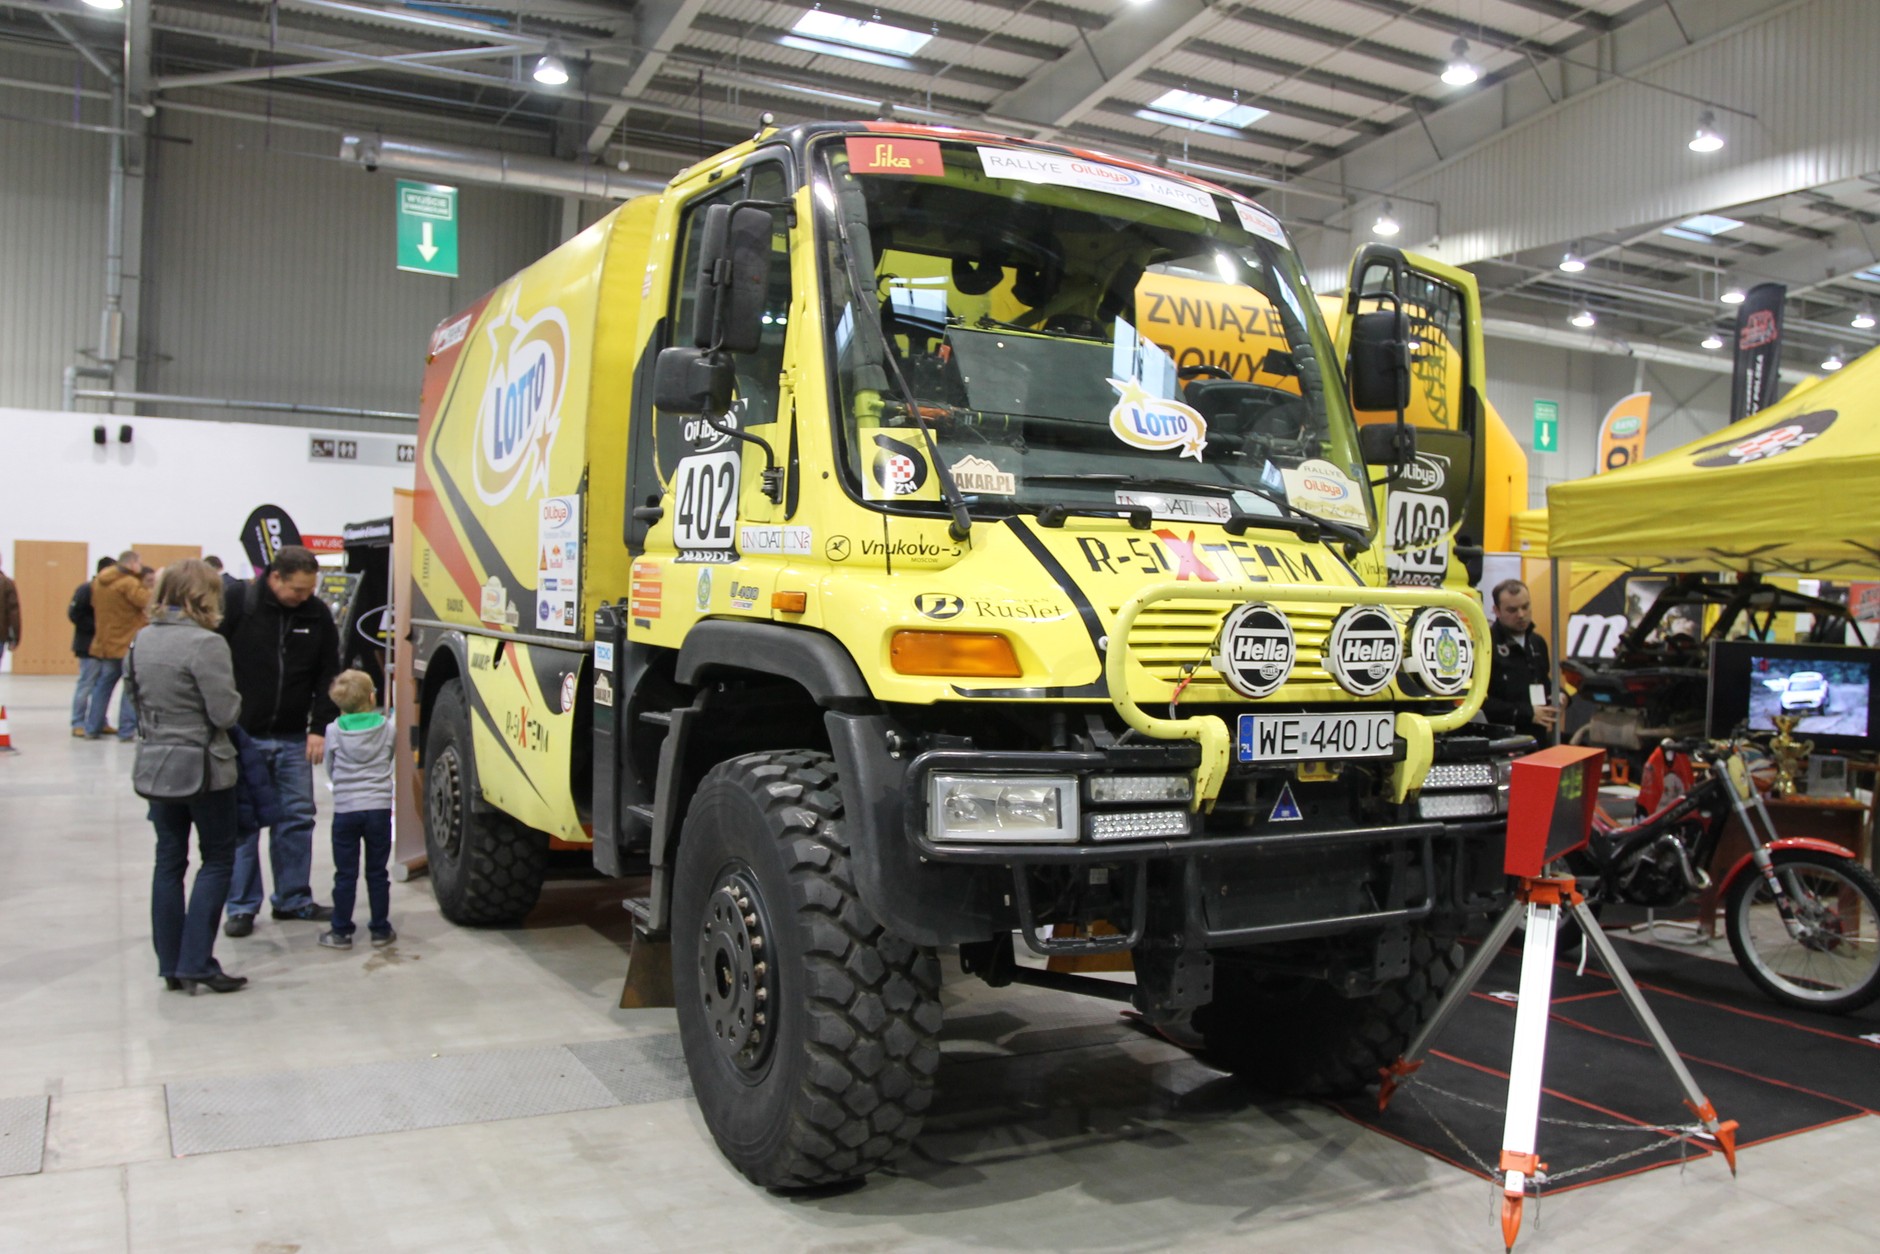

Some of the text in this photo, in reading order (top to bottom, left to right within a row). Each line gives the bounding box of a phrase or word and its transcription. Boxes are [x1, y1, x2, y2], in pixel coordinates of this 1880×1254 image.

[869, 144, 912, 168] Sika
[989, 155, 1063, 174] RALLYE
[1071, 162, 1129, 184] OiLibya
[1150, 183, 1210, 208] MAROC
[493, 352, 546, 460] LOTTO
[1131, 408, 1188, 437] LOTTO
[955, 472, 1014, 493] AKAR.PL
[1303, 465, 1343, 479] RALLYE
[1303, 478, 1343, 497] OiLibya
[678, 461, 736, 541] 402
[1389, 573, 1441, 586] MAROC
[1234, 637, 1289, 662] Hella
[1343, 639, 1396, 663] Hella
[1241, 743, 1252, 753] PL
[1259, 720, 1300, 756] WE
